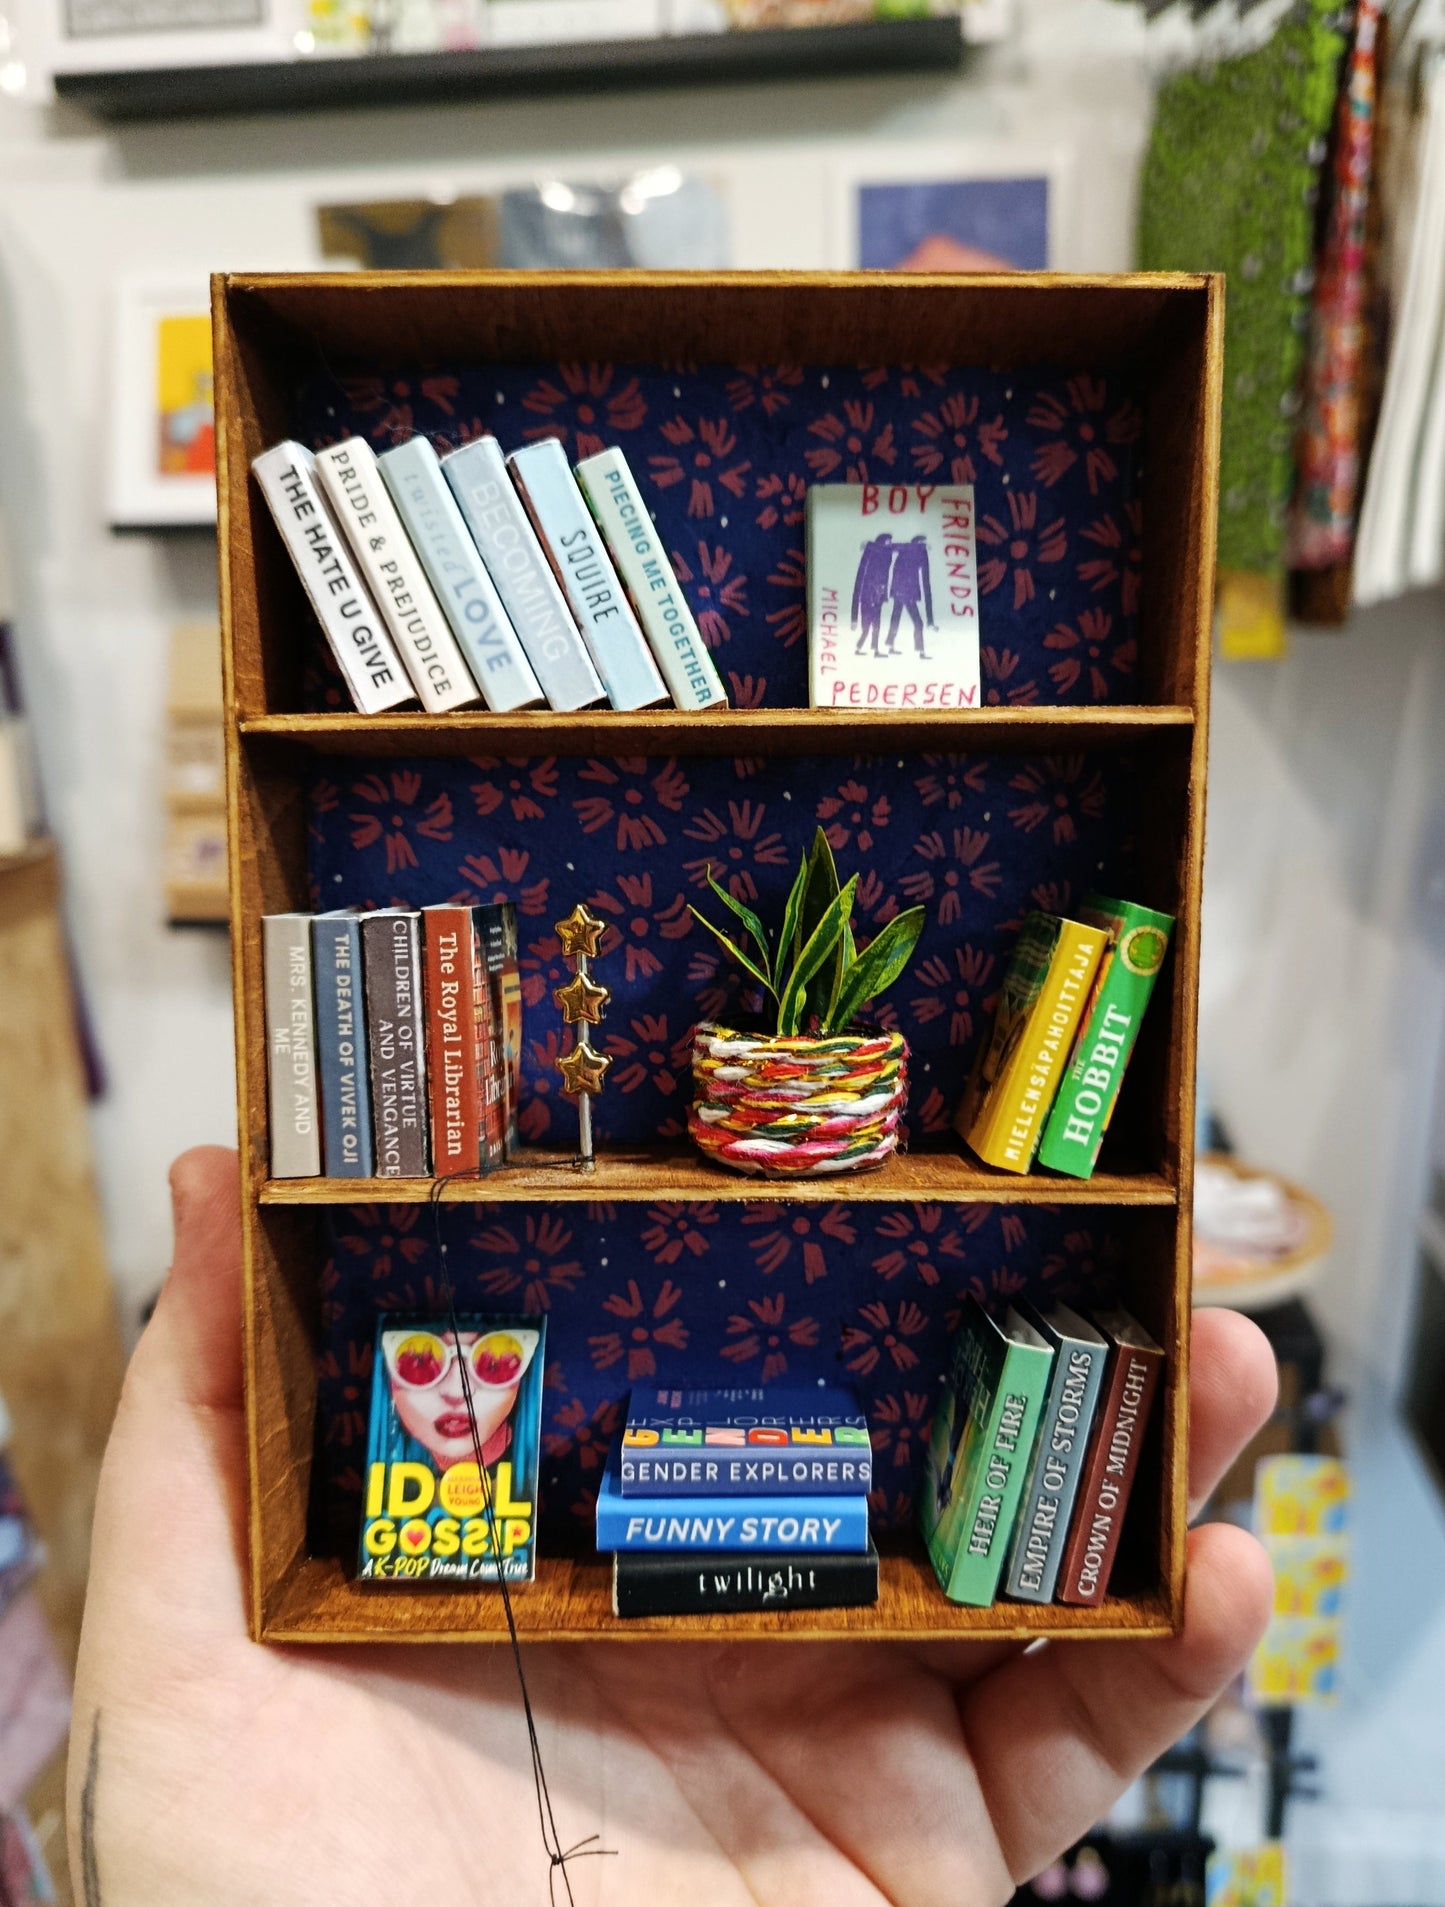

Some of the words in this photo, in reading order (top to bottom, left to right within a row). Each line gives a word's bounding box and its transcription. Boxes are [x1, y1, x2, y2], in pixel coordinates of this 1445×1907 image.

[861, 483, 936, 516] BOY
[280, 464, 316, 521] THE
[304, 524, 351, 595] HATE
[340, 599, 361, 619] U
[352, 625, 394, 689] GIVE
[331, 450, 378, 528] PRIDE
[369, 536, 386, 553] &
[380, 561, 453, 696] PREJUDICE
[472, 479, 569, 663] BECOMING
[560, 529, 619, 623] SQUIRE
[605, 469, 650, 556] PIECING
[642, 560, 666, 592] ME
[657, 594, 712, 703] TOGETHER
[942, 498, 974, 618] FRIENDS
[453, 578, 512, 673] LOVE
[820, 587, 839, 676] MICHAEL
[832, 681, 977, 707] PEDERSEN
[289, 946, 308, 992] MRS.
[335, 934, 350, 969] THE
[392, 920, 412, 1018] CHILDREN
[439, 932, 457, 975] The
[336, 976, 352, 1036] DEATH
[437, 981, 462, 1043] Royal
[275, 1028, 291, 1055] ME
[291, 998, 310, 1094] KENNEDY
[338, 1042, 354, 1067] OF
[379, 1019, 395, 1060] AND
[397, 1025, 413, 1049] OF
[1004, 943, 1094, 1160] MIELENSÄPAHOITTAJA
[340, 1073, 357, 1129] VIVEK
[399, 1060, 417, 1129] VIRTUE
[443, 1049, 465, 1156] Librarian
[1063, 1003, 1133, 1147] HOBBIT
[295, 1094, 312, 1135] AND
[381, 1068, 401, 1176] VENGANCE
[342, 1134, 358, 1163] OJI
[997, 1393, 1027, 1452] FIRE
[1051, 1350, 1092, 1453] STORMS
[1105, 1357, 1147, 1476] MIDNIGHT
[366, 1461, 532, 1518] IDOL
[622, 1462, 718, 1481] GENDER
[730, 1462, 871, 1481] EXPLORERS
[985, 1455, 1012, 1490] OF
[1043, 1456, 1069, 1492] OF
[1099, 1479, 1120, 1510] OF
[364, 1518, 531, 1556] GOSSIP
[626, 1517, 736, 1543] FUNNY
[739, 1517, 841, 1543] STORY
[968, 1494, 1001, 1556] HEIR
[1020, 1496, 1059, 1591] EMPIRE
[362, 1558, 374, 1576] A
[374, 1555, 430, 1577] K-POP
[430, 1558, 468, 1576] Dream
[699, 1566, 816, 1603] twilight
[1078, 1513, 1114, 1597] CROWN
